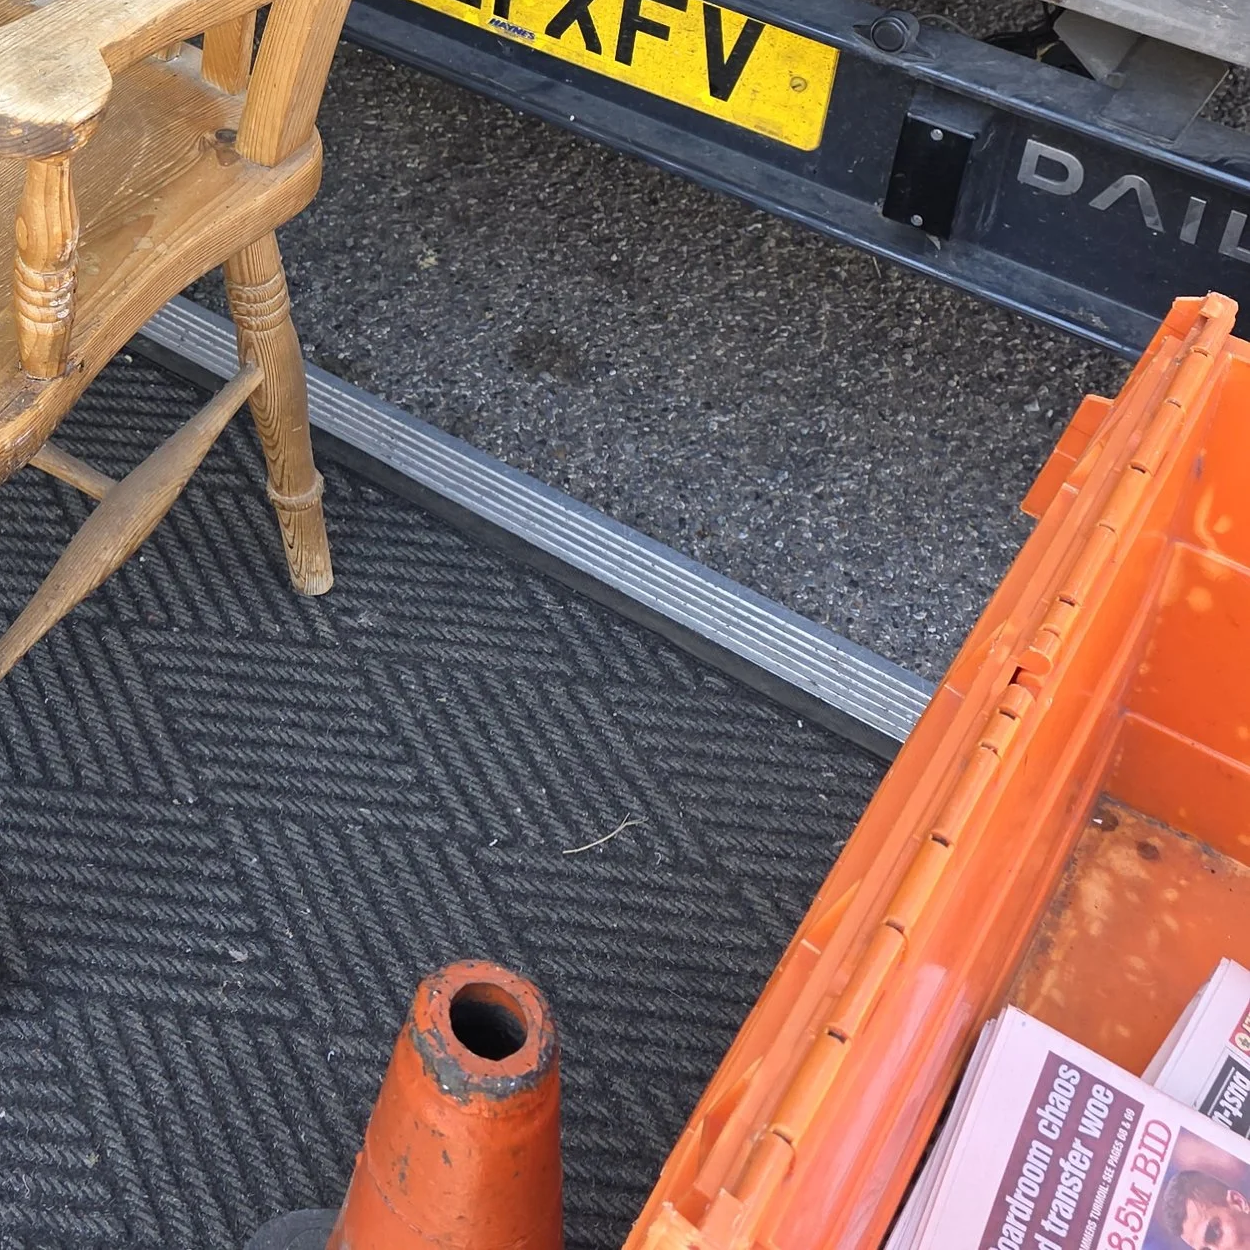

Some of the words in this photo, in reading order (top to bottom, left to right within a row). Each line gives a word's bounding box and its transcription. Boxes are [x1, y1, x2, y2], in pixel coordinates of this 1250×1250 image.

[488, 18, 536, 40] HAYNES
[1121, 1121, 1131, 1130] &
[988, 1139, 1053, 1250] oardroom
[1036, 1064, 1081, 1141] chaos
[1040, 1137, 1094, 1238] transfer
[1078, 1083, 1114, 1139] woe
[1107, 1139, 1124, 1168] PAGES
[1130, 1119, 1172, 1185] BID
[1102, 1165, 1115, 1184] SEE
[1089, 1181, 1110, 1221] TURMOIL:
